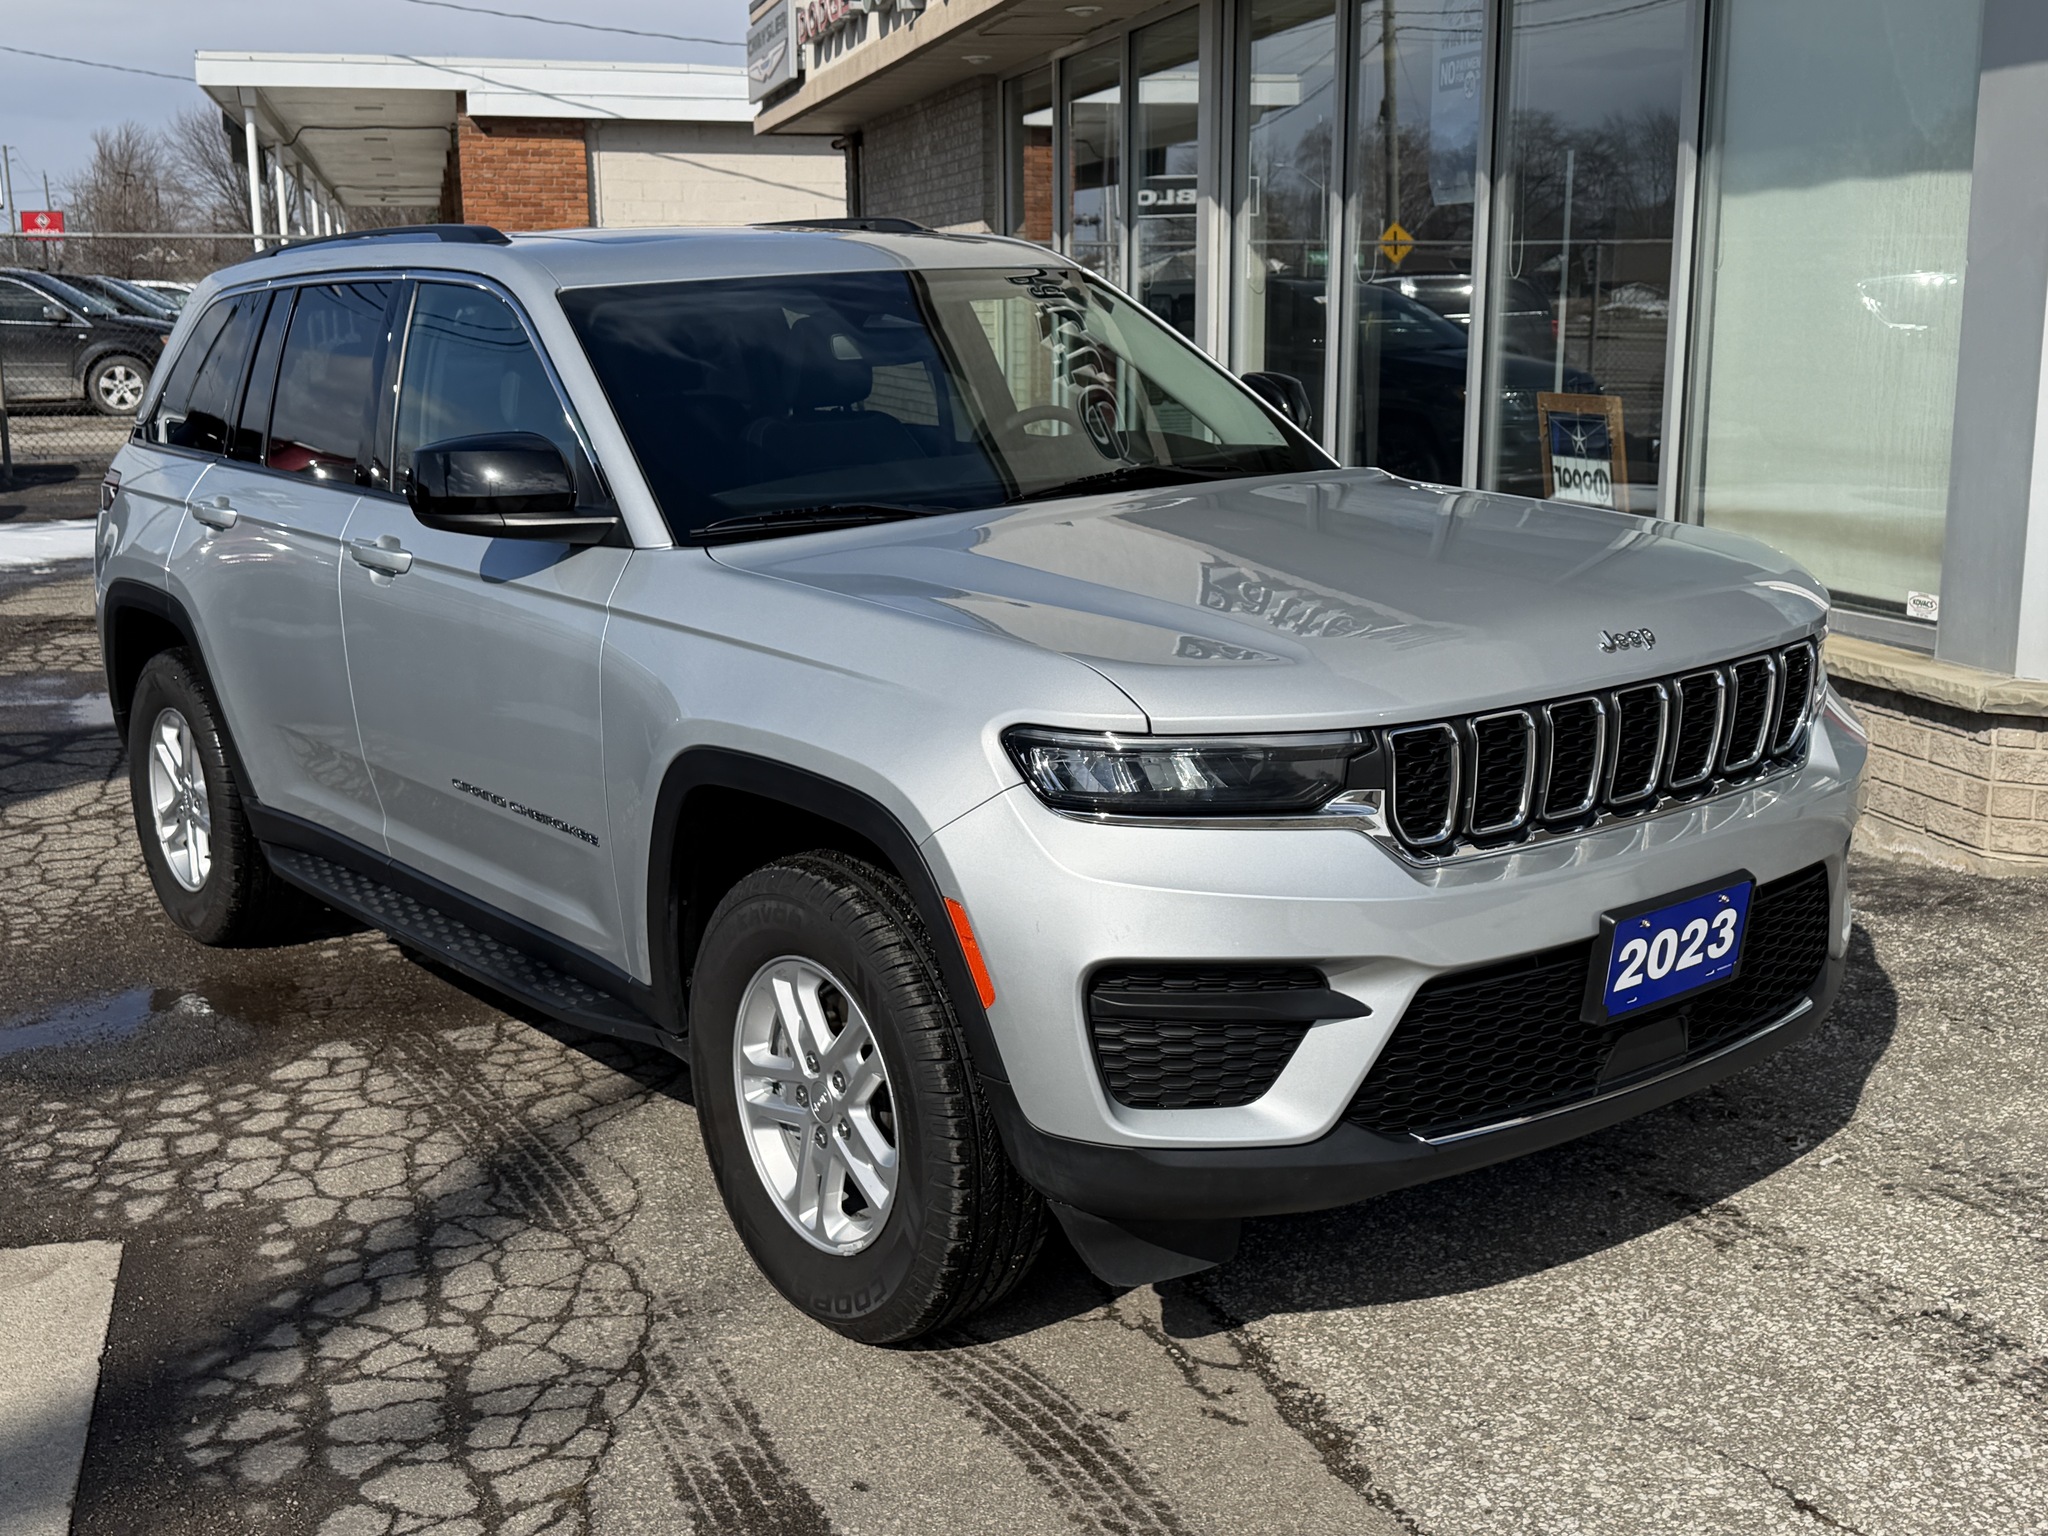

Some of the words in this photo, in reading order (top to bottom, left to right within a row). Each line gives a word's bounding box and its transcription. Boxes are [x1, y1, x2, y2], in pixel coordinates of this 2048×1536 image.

[1440, 61, 1455, 87] NO
[1456, 56, 1480, 72] PAYMEN
[1597, 627, 1657, 654] Jeep
[451, 778, 507, 809] GRAND
[509, 801, 601, 848] CHEROKEE
[1612, 907, 1738, 993] 2023
[794, 1275, 889, 1316] COOP
